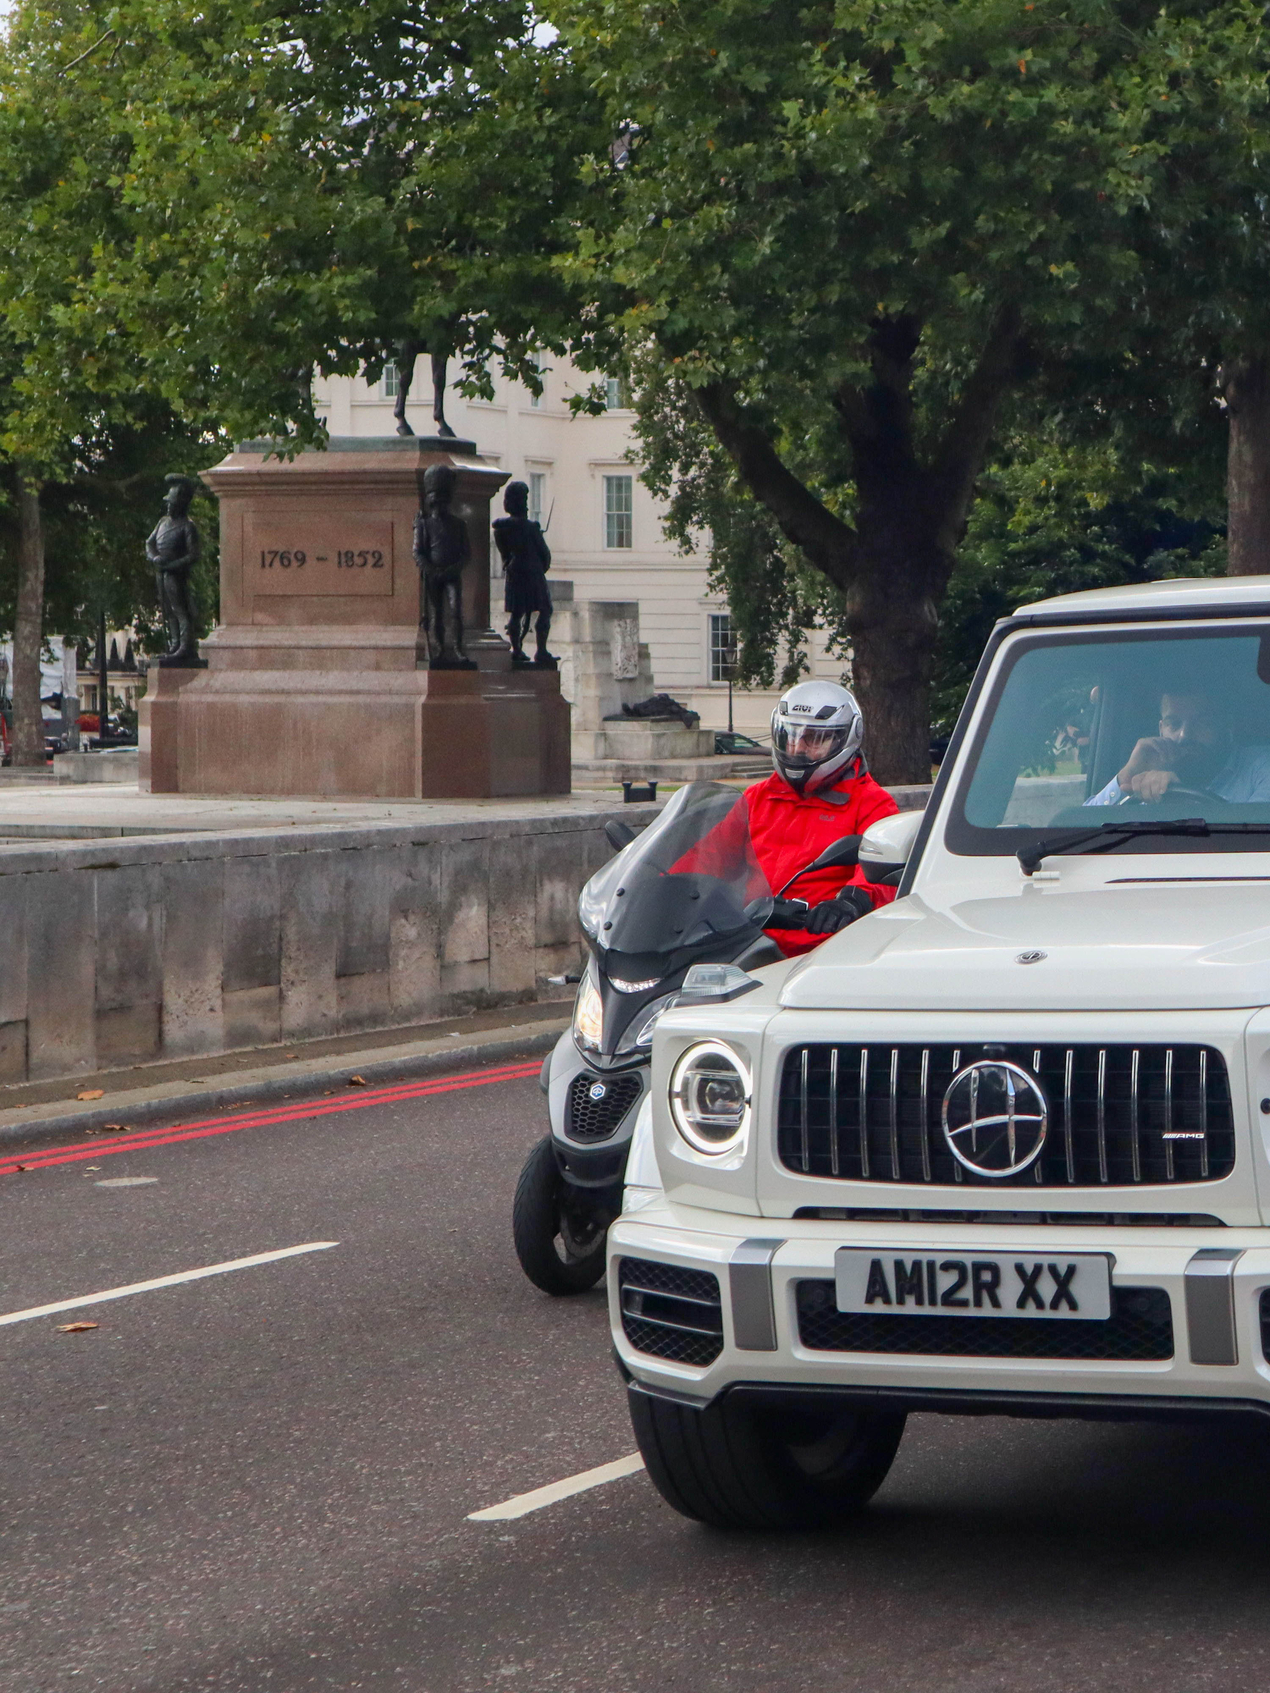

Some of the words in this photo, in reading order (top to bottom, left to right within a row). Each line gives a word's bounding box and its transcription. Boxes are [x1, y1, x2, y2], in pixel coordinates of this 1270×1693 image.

[260, 550, 307, 569] 1769
[336, 550, 384, 569] 1852
[792, 704, 812, 713] GIVI
[1014, 1261, 1080, 1312] XX
